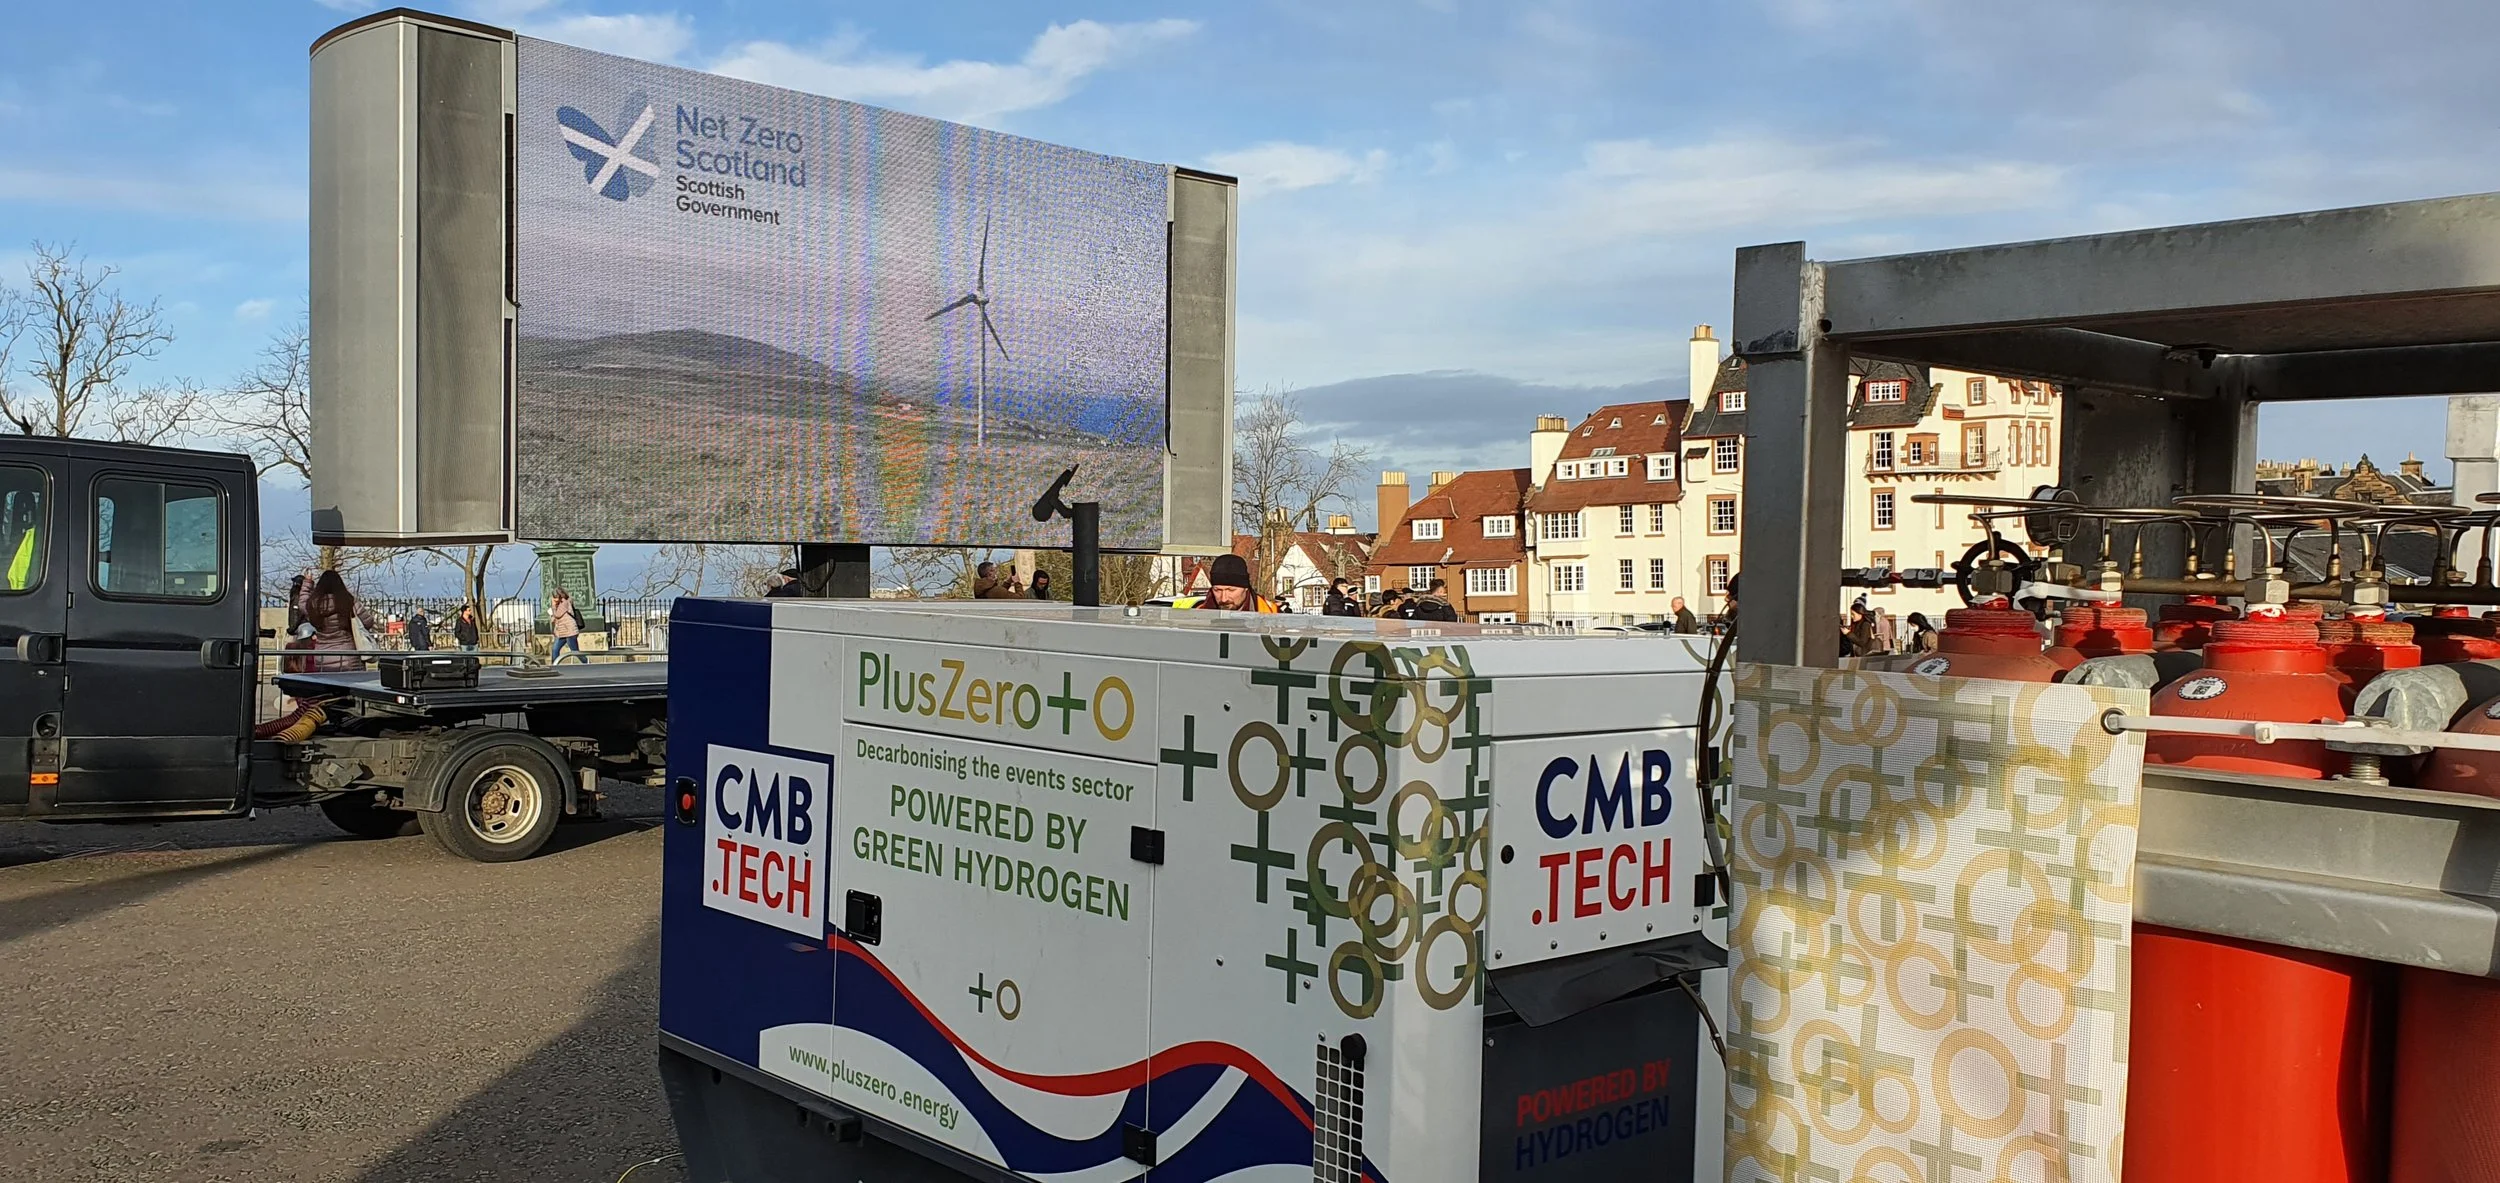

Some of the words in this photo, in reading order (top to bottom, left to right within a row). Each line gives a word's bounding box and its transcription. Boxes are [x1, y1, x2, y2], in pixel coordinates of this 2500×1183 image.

[675, 104, 729, 142] Net
[738, 116, 804, 154] Zero
[675, 139, 807, 188] Scotland
[675, 175, 745, 201] Scottish
[675, 196, 781, 226] Government
[714, 763, 814, 846] CMB
[856, 738, 968, 781] Decarbonising
[972, 756, 1001, 780] the
[1006, 764, 1066, 792] events
[1071, 776, 1134, 802] sector
[1535, 749, 1673, 840] CMB
[890, 784, 1034, 844] POWERED
[1046, 812, 1088, 855] BY
[711, 837, 811, 919] .TECH
[853, 826, 943, 878] GREEN
[954, 846, 1130, 922] HYDROGEN
[1531, 837, 1672, 927] .TECH
[788, 1045, 960, 1131] www.pluszero.energy
[1516, 1067, 1638, 1128] POWERED
[1642, 1057, 1673, 1095] BY
[1515, 1094, 1670, 1172] HYDROGEN
